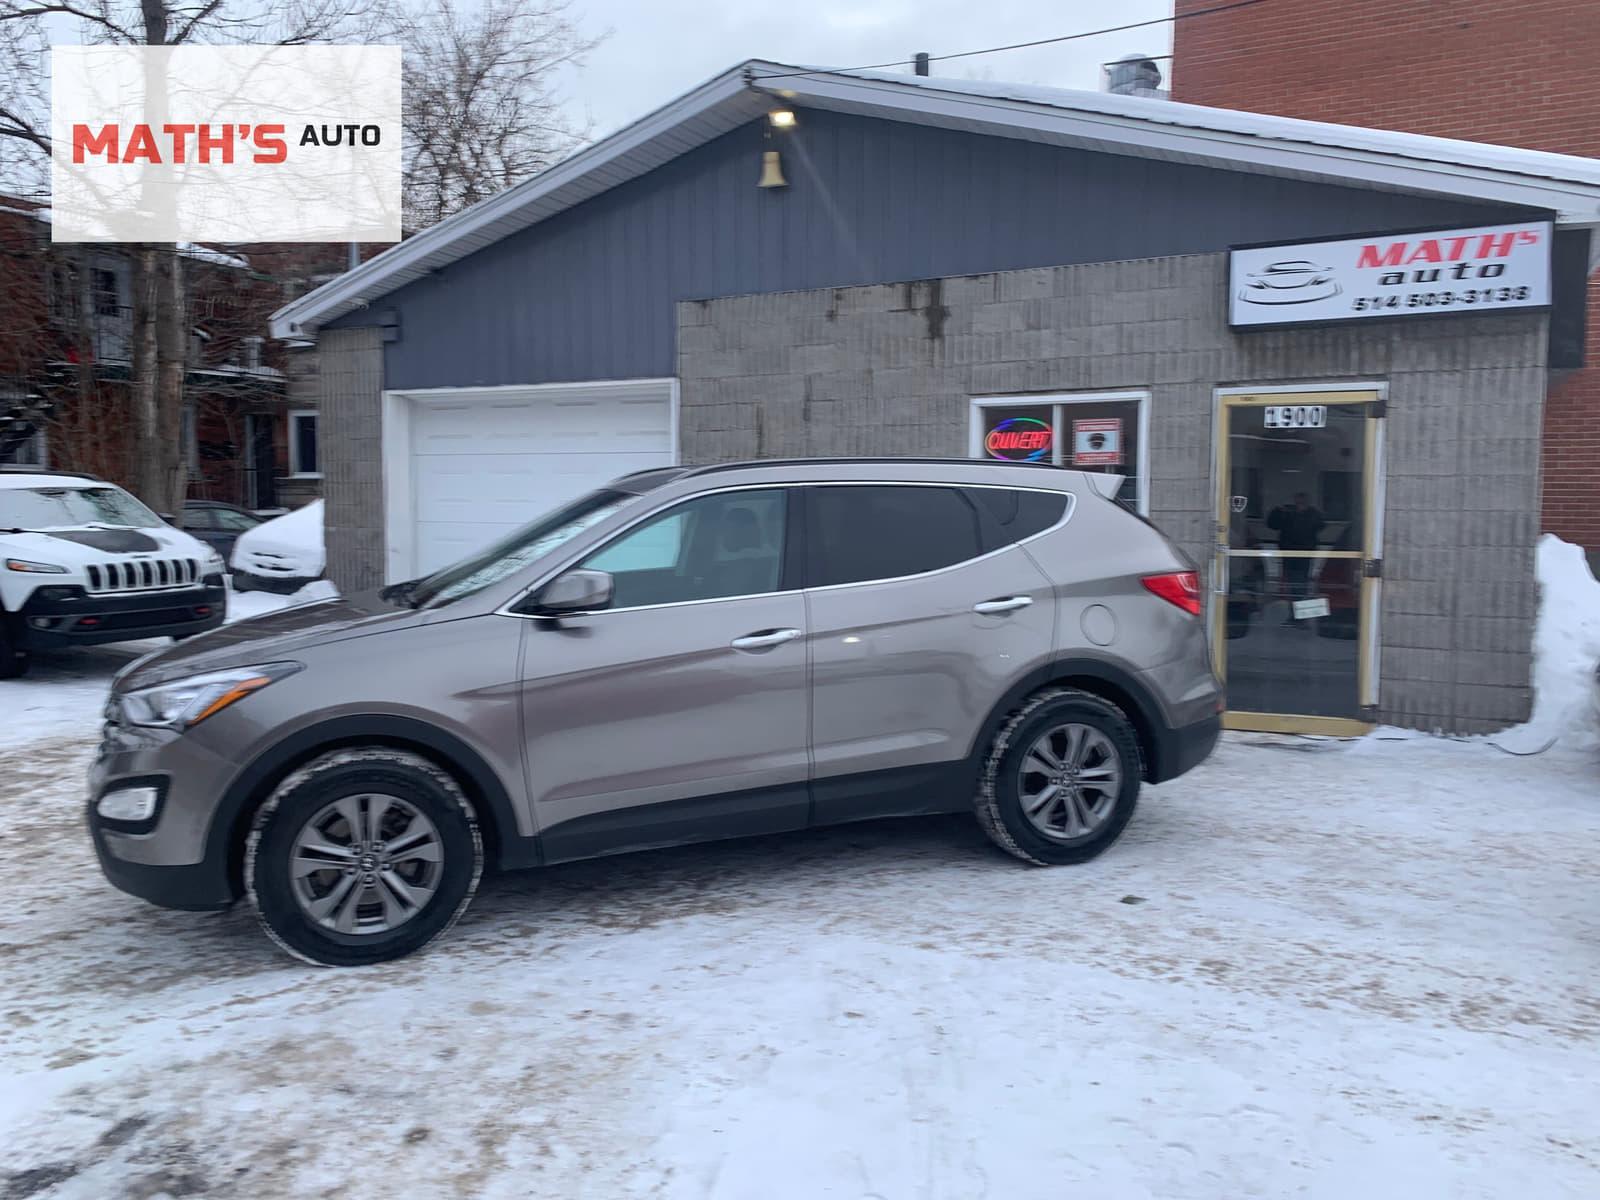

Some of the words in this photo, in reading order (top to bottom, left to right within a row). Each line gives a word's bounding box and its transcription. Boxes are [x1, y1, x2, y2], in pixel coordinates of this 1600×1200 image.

[1378, 262, 1506, 286] auto
[1352, 294, 1400, 311] 514
[1265, 407, 1321, 427] 1900
